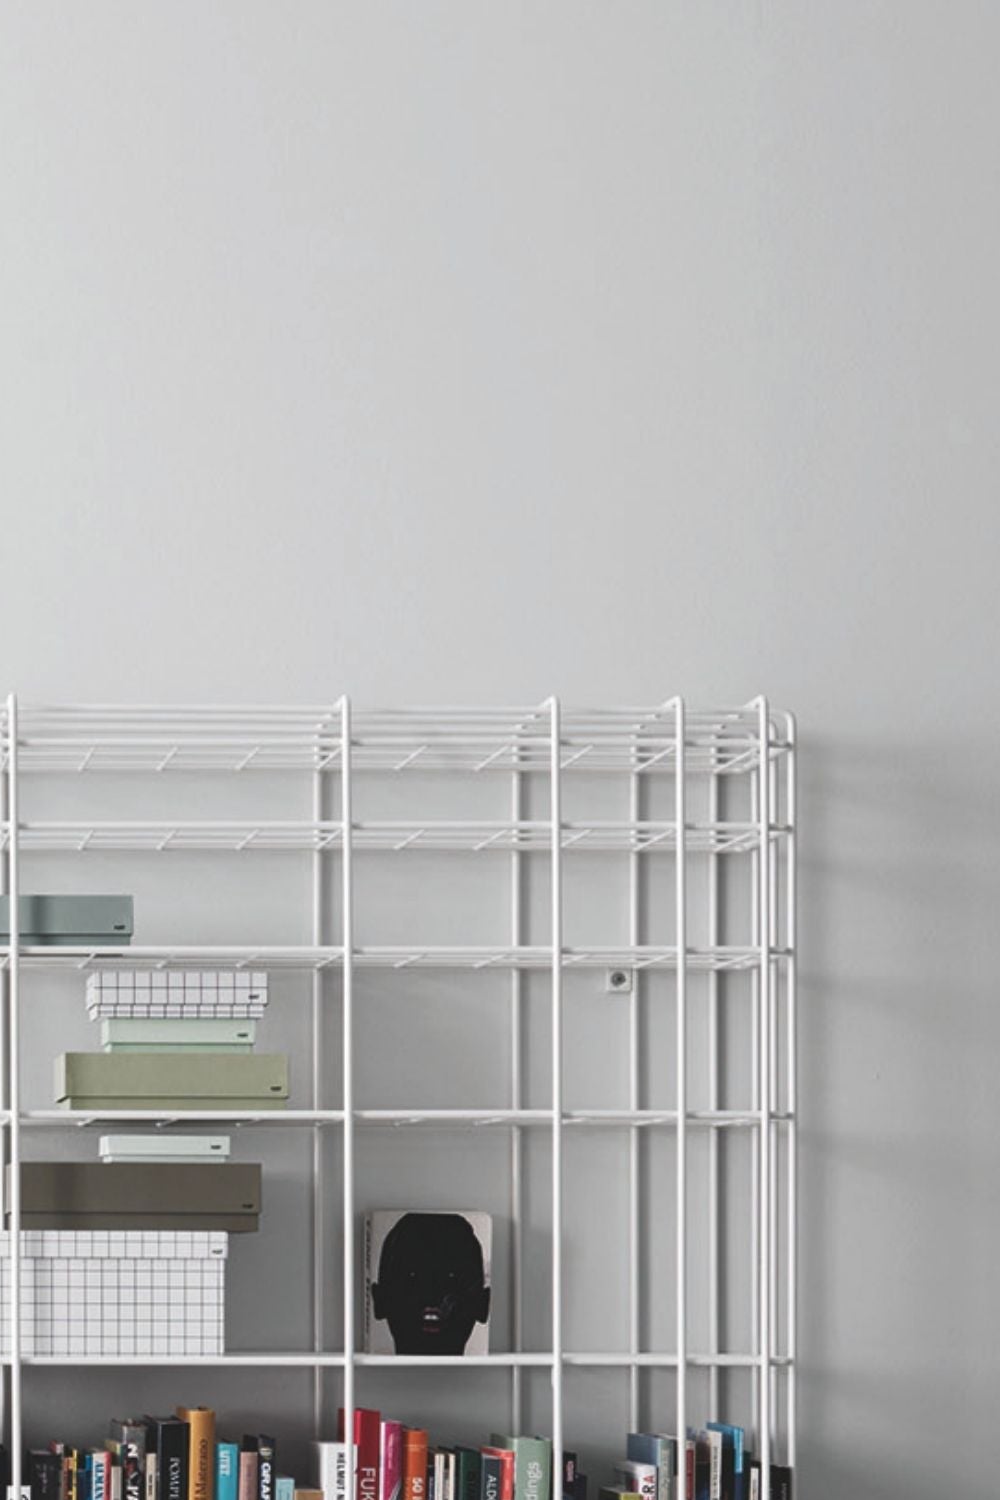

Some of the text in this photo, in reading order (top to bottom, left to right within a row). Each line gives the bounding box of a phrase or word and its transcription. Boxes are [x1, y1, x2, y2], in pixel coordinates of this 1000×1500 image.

[195, 1439, 208, 1495] Materano
[335, 1452, 345, 1491] HELMUT
[411, 1476, 423, 1494] 50
